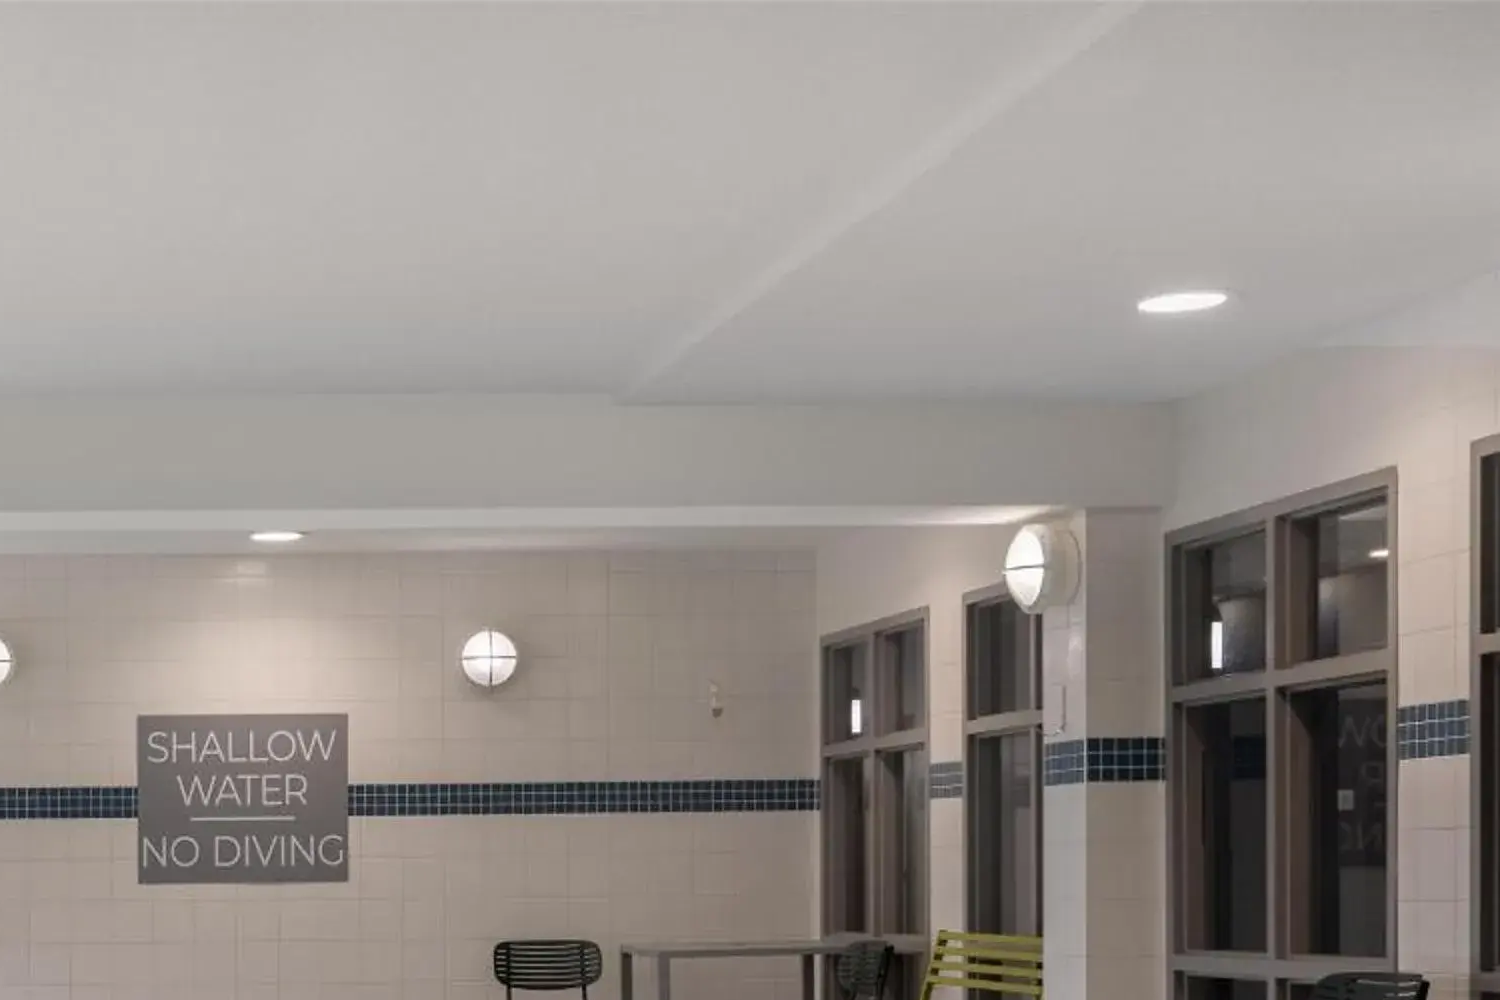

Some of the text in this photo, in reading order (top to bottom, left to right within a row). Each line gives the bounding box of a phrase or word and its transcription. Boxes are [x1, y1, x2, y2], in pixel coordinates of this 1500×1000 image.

[146, 729, 337, 764] SHALLOW
[175, 774, 309, 807] WATER
[142, 834, 344, 868] NO DIVING
